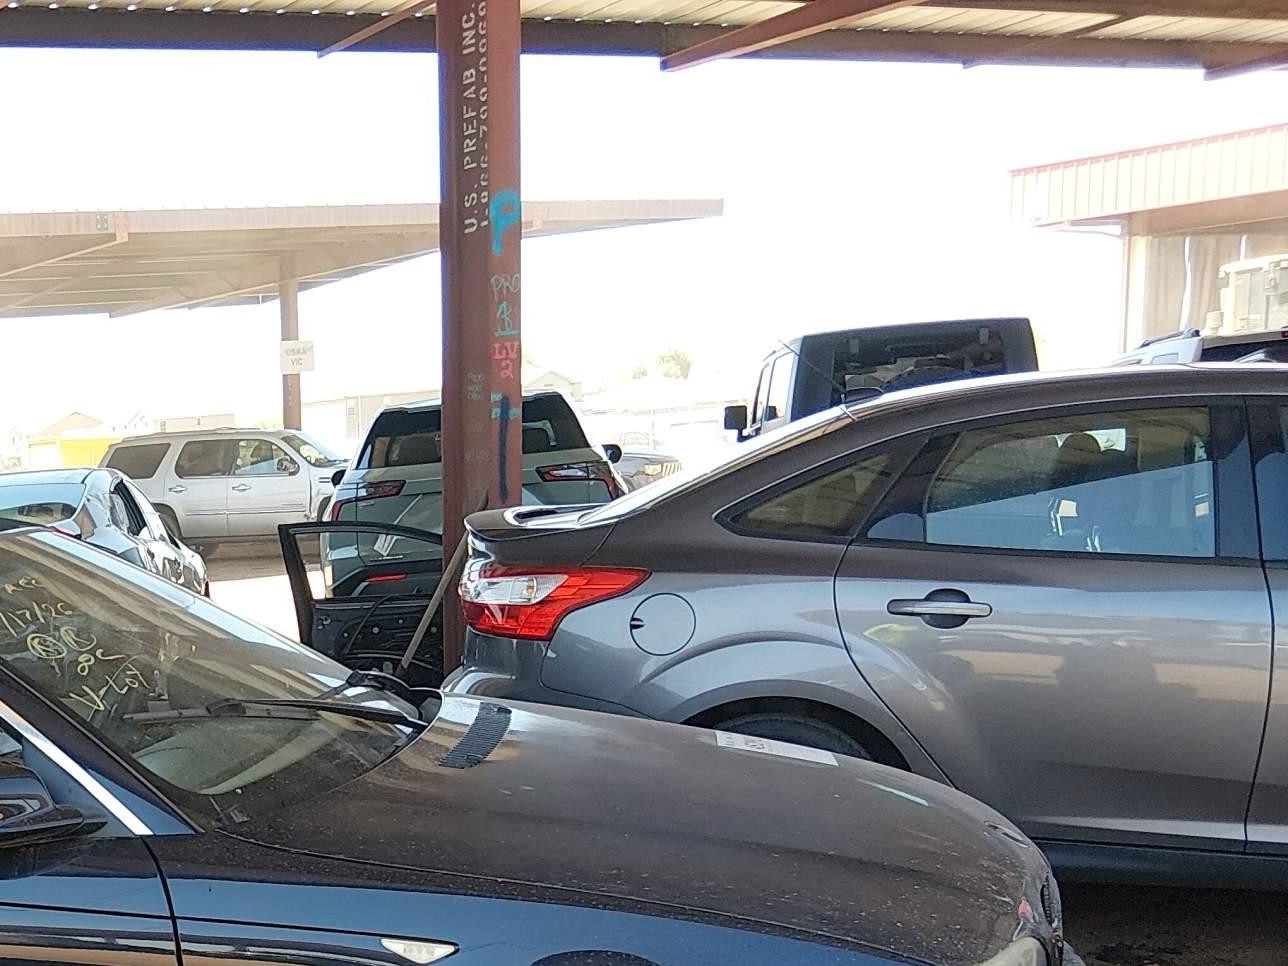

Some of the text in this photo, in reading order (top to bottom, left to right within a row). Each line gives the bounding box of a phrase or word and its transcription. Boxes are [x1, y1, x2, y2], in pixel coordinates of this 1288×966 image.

[461, 2, 479, 235] U.S. PREFAB INC.
